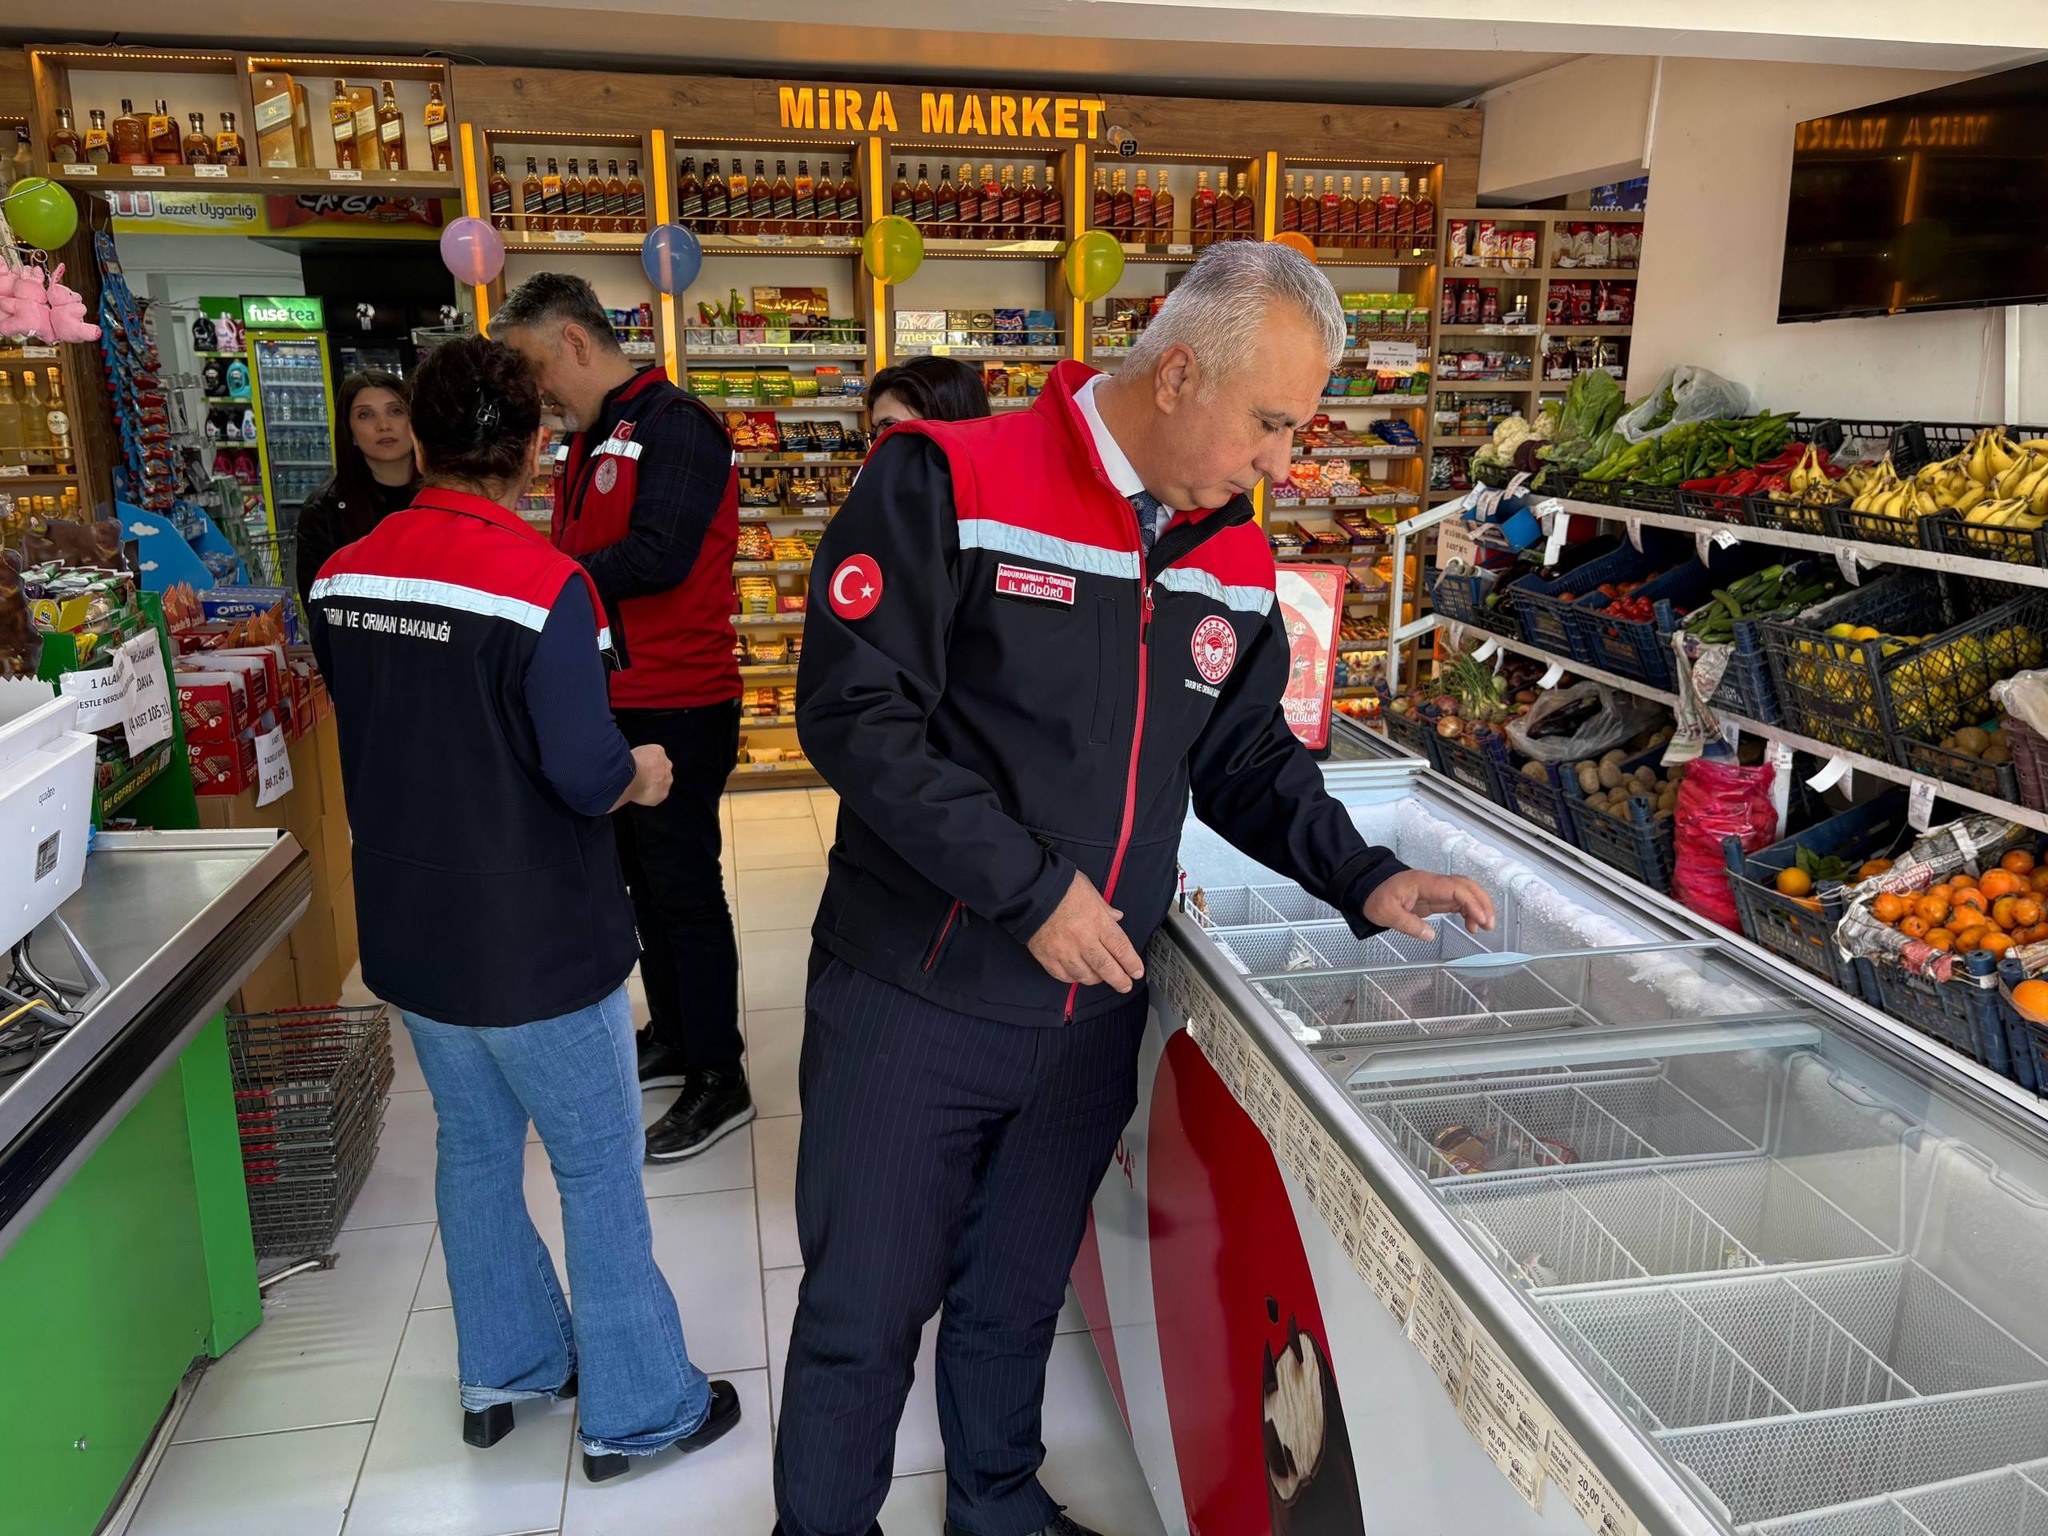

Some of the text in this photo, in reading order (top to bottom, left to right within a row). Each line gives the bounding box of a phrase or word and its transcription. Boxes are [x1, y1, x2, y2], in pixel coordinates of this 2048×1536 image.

[921, 92, 1106, 140] MARKET
[159, 201, 196, 216] Lezzet
[200, 202, 257, 220] Uygarlığı
[248, 304, 316, 322] fusetea
[1000, 568, 1044, 583] ABDURRAHMAN
[1020, 582, 1064, 599] MÜDÜRÜ
[217, 604, 255, 615] OREO
[346, 610, 360, 628] VE
[362, 612, 398, 634] ORMAN
[399, 617, 452, 643] BAKANLIĞI
[91, 678, 98, 690] 1
[136, 673, 154, 692] DAVA
[77, 698, 102, 710] ESTLE
[148, 703, 161, 722] 105
[1381, 1226, 1396, 1248] 20,00
[1496, 1378, 1515, 1405] 20,00
[1487, 1426, 1507, 1452] 40,00
[1578, 1474, 1600, 1506] 20,00
